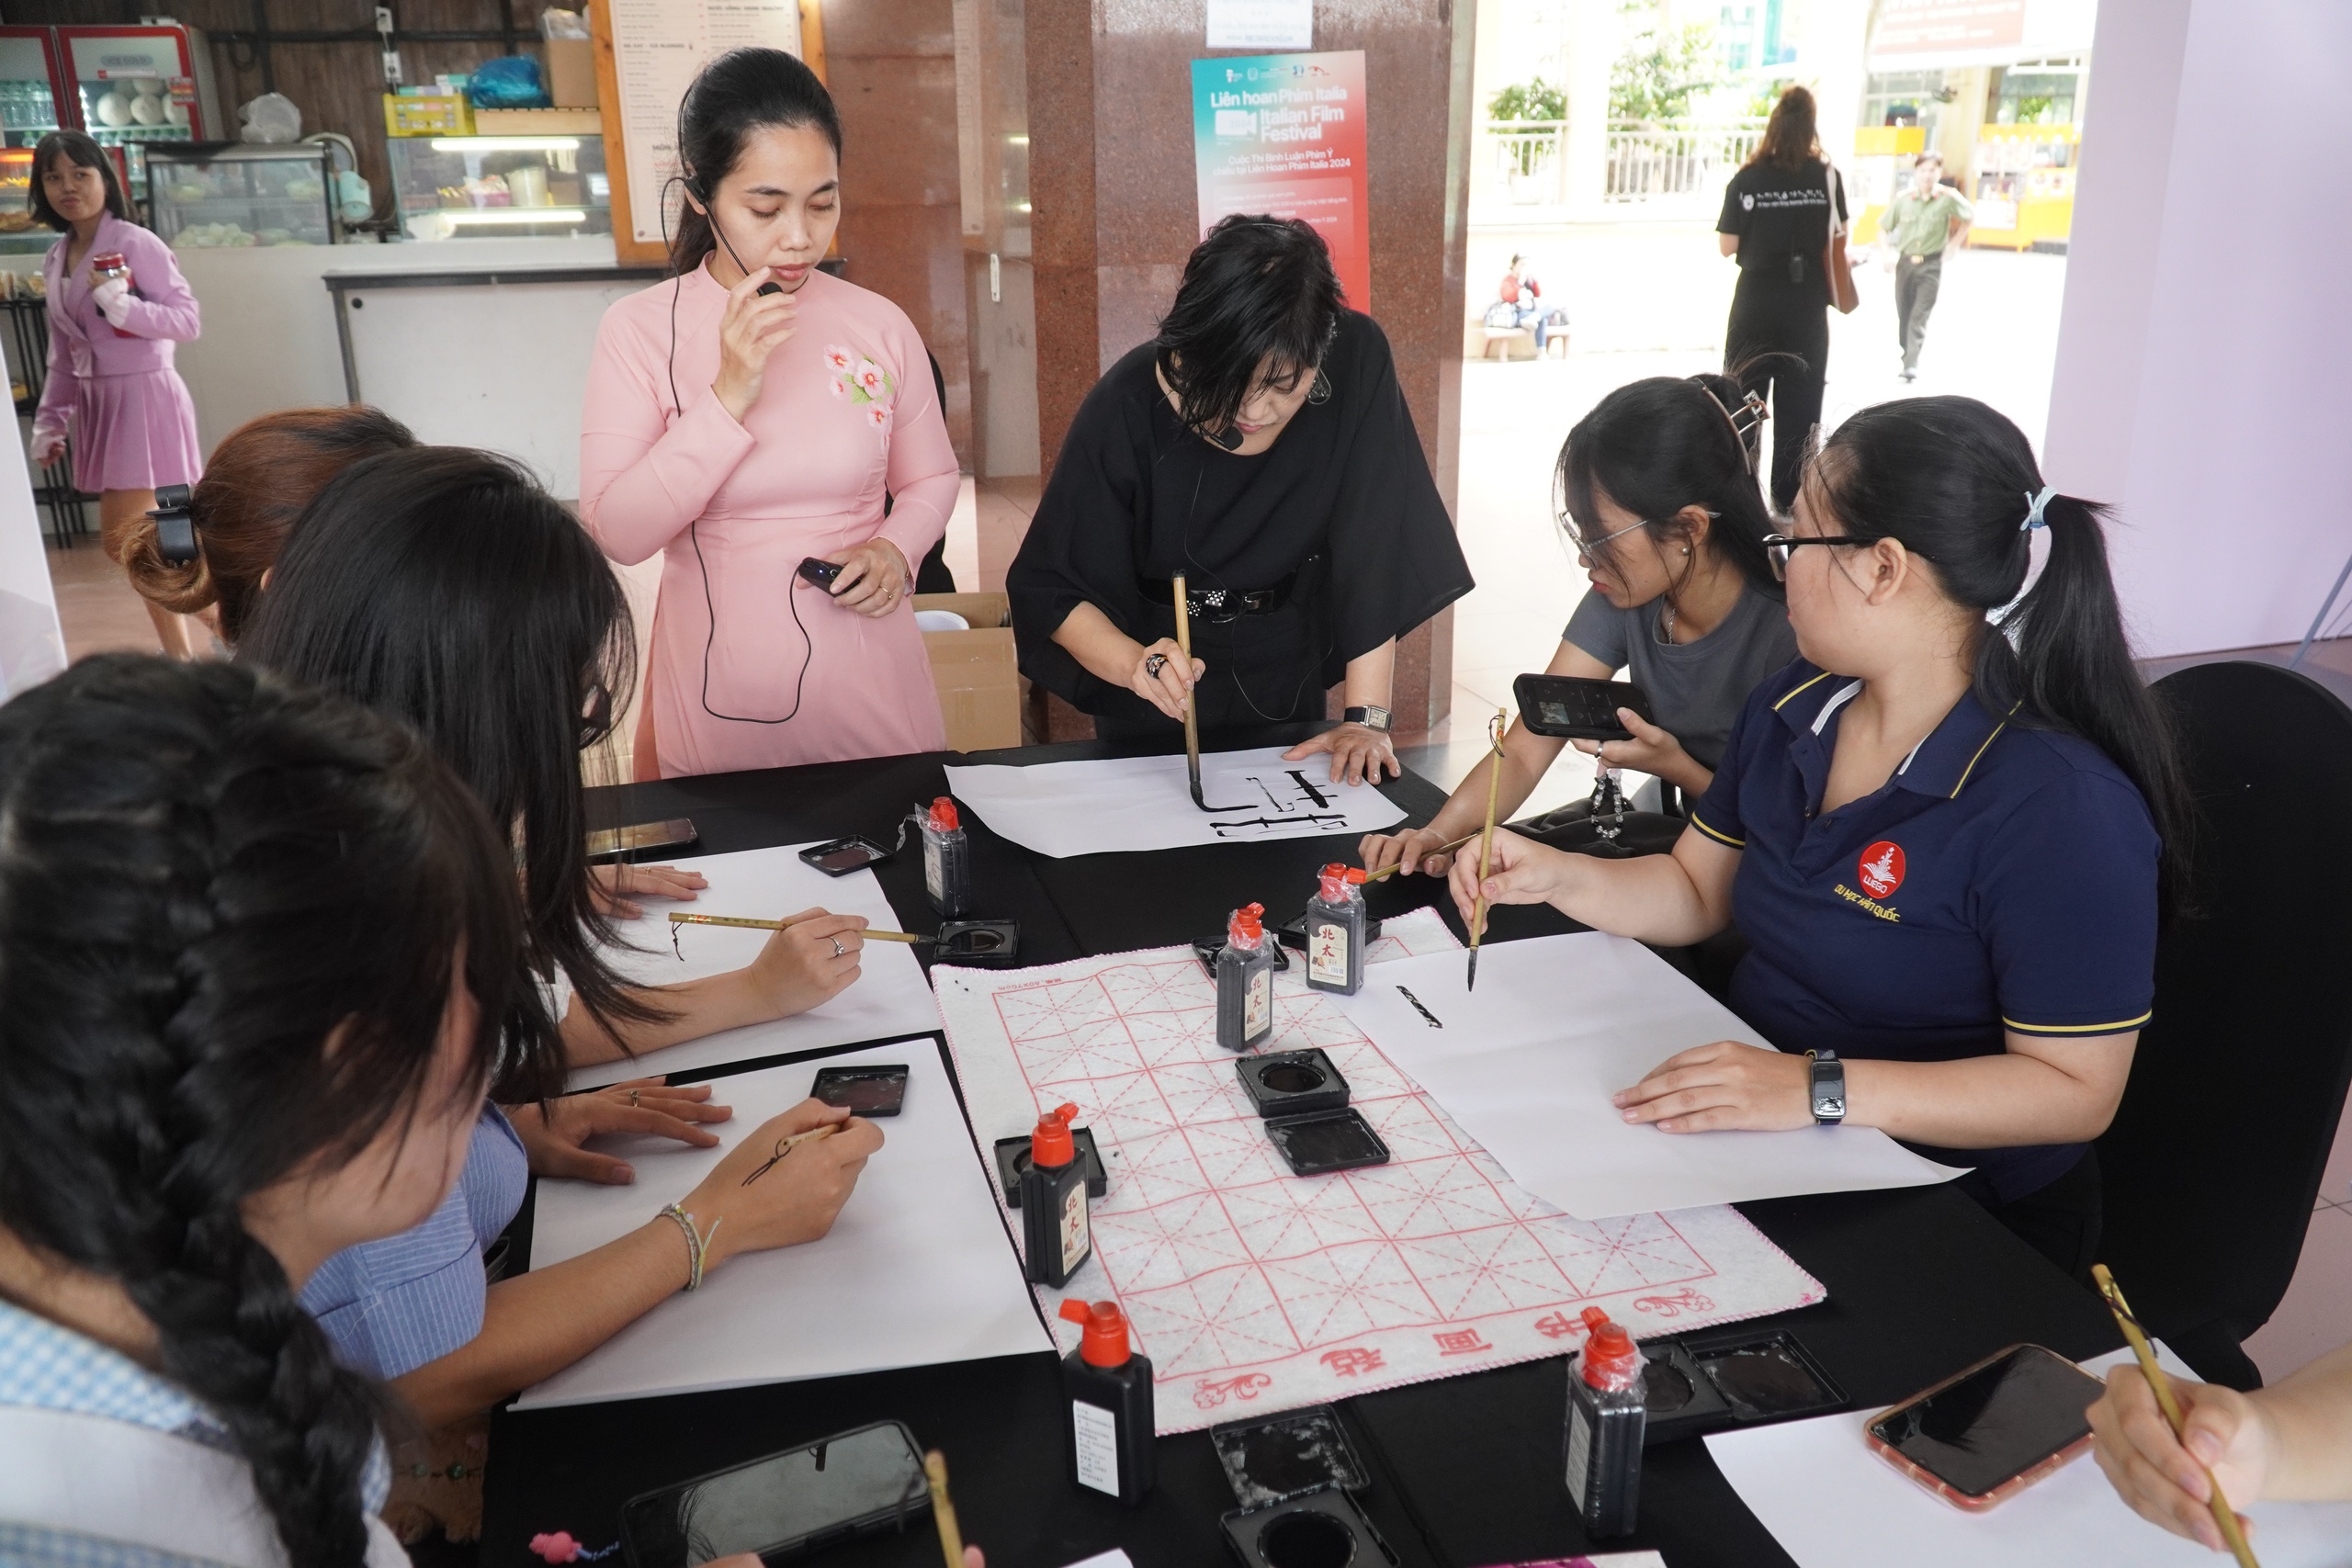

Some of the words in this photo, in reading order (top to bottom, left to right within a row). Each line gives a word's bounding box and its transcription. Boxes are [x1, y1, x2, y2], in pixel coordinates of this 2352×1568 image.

[1211, 92, 1240, 107] Liên
[1242, 91, 1277, 106] hoan
[1279, 89, 1313, 103] Phim
[1316, 86, 1347, 101] Italia
[1261, 107, 1307, 125] Italian
[1311, 106, 1344, 121] Film
[1261, 123, 1322, 142] Festival
[1306, 150, 1326, 159] Phim
[1266, 163, 1287, 172] Hoan
[1289, 161, 1309, 171] Phim
[1310, 160, 1329, 169] Italia
[1329, 158, 1351, 168] 2024
[1321, 927, 1336, 958] 北太
